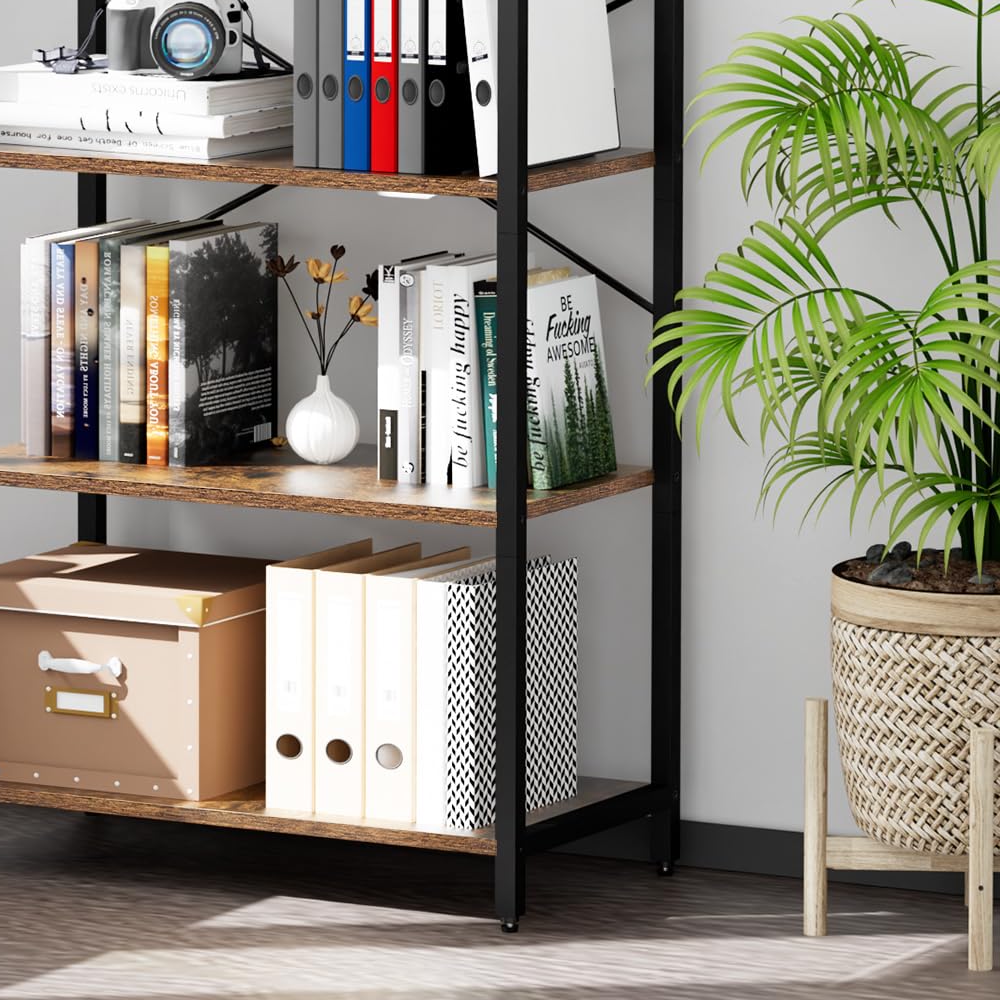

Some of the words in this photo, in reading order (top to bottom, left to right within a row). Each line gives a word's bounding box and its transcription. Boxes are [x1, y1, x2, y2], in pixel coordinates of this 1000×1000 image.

[37, 133, 51, 141] for
[560, 295, 573, 312] BE
[450, 293, 470, 354] happy
[481, 312, 497, 348] Dreaming
[546, 310, 591, 342] Fucking
[547, 336, 596, 363] AWESOME
[452, 362, 472, 443] fucking
[452, 445, 468, 468] be
[532, 450, 545, 471] be
